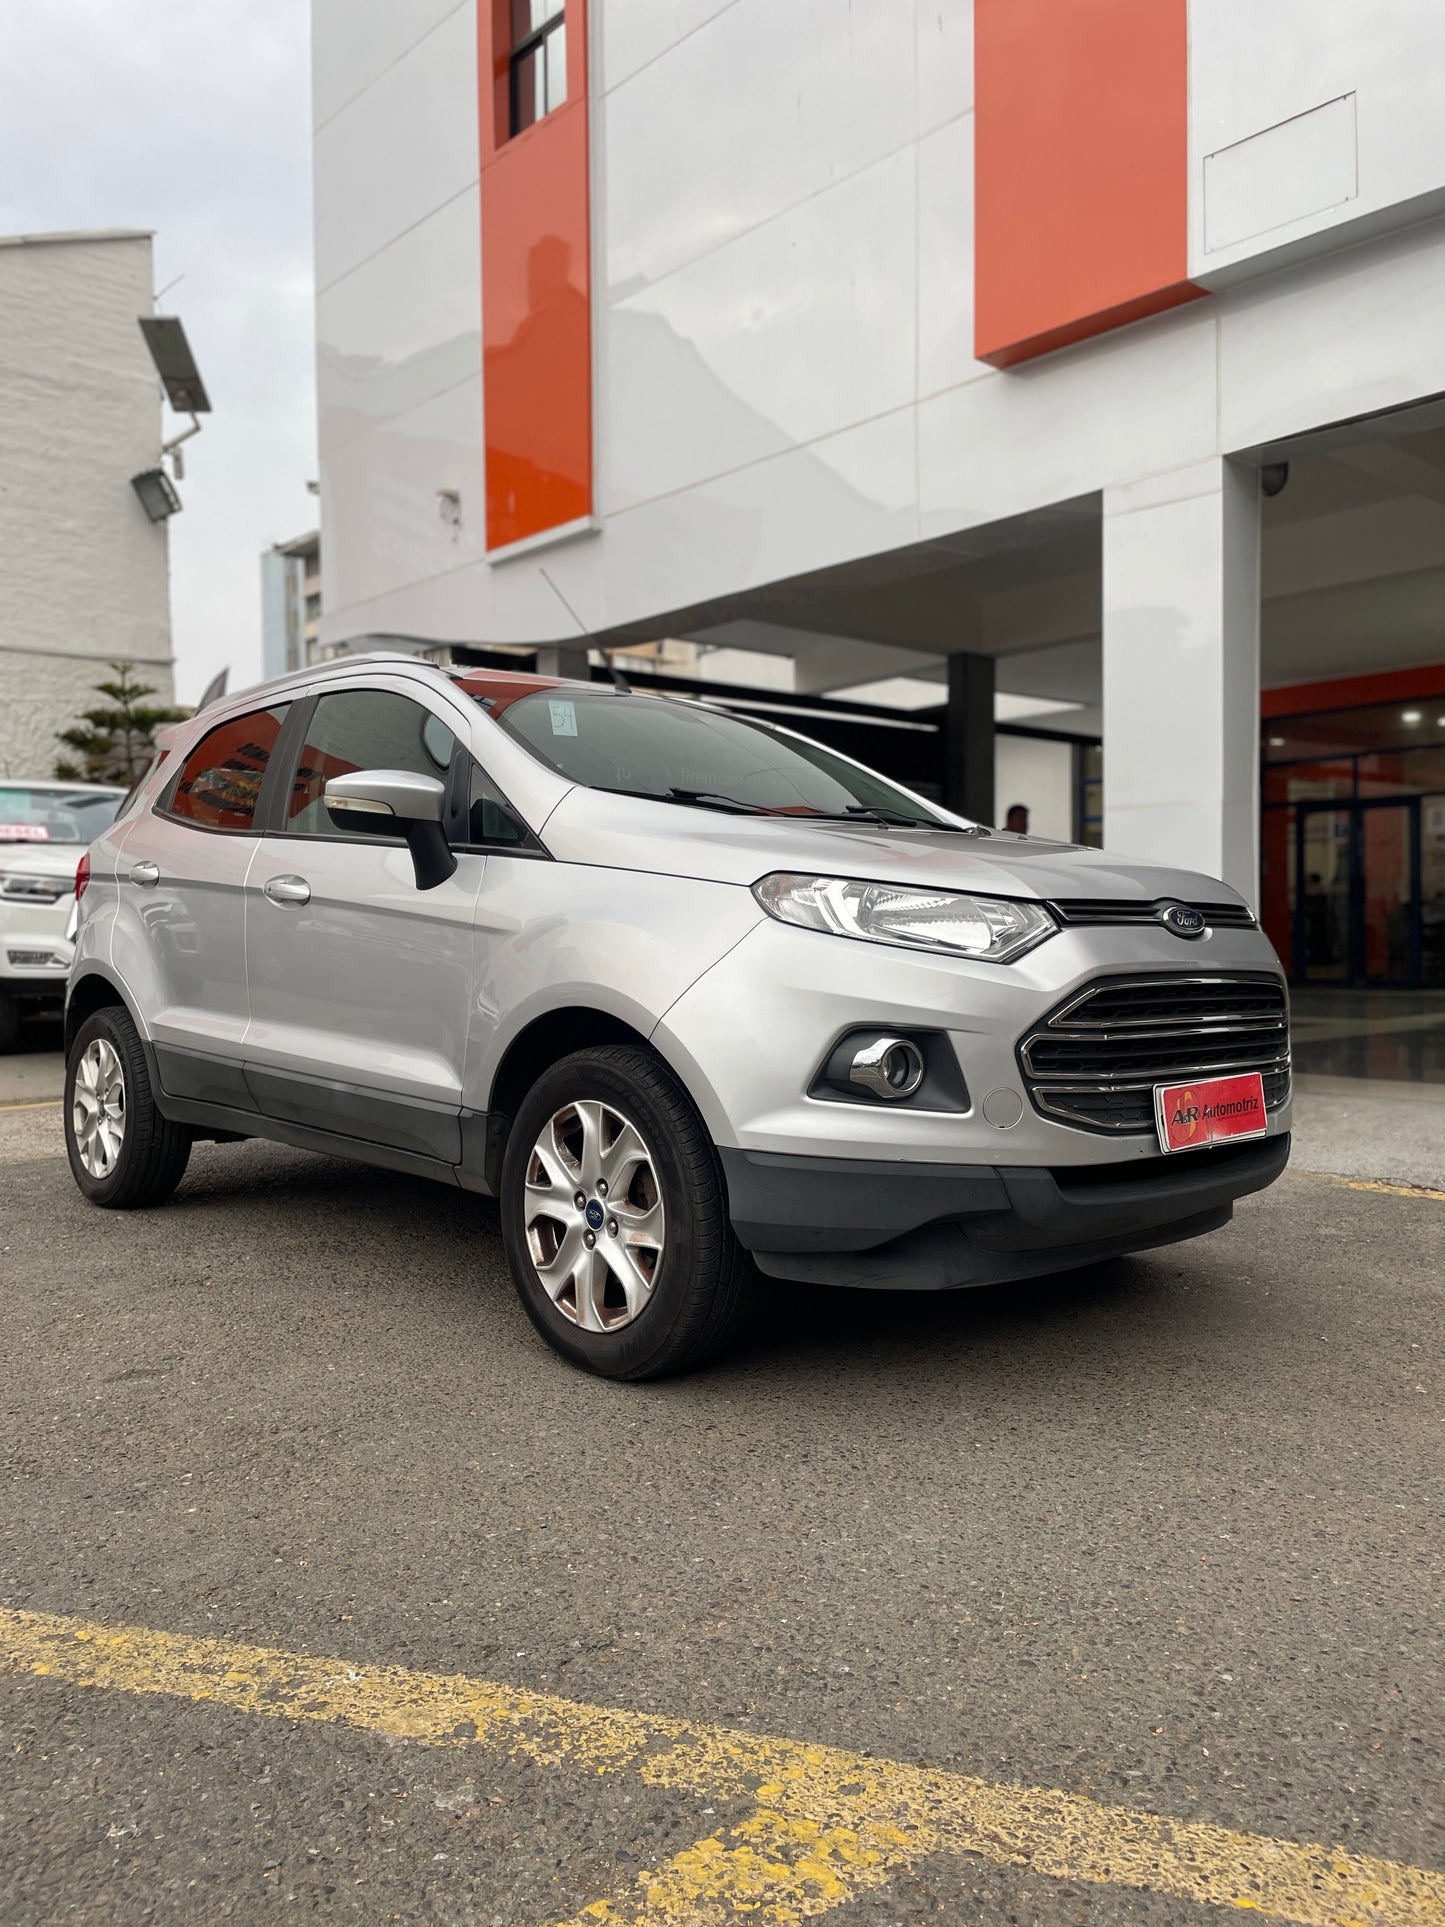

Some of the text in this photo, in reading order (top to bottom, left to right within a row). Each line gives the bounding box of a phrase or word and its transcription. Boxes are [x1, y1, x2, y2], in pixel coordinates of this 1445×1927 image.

[552, 704, 574, 731] 54
[1176, 910, 1199, 926] Ford
[1202, 1096, 1259, 1120] Automotriz
